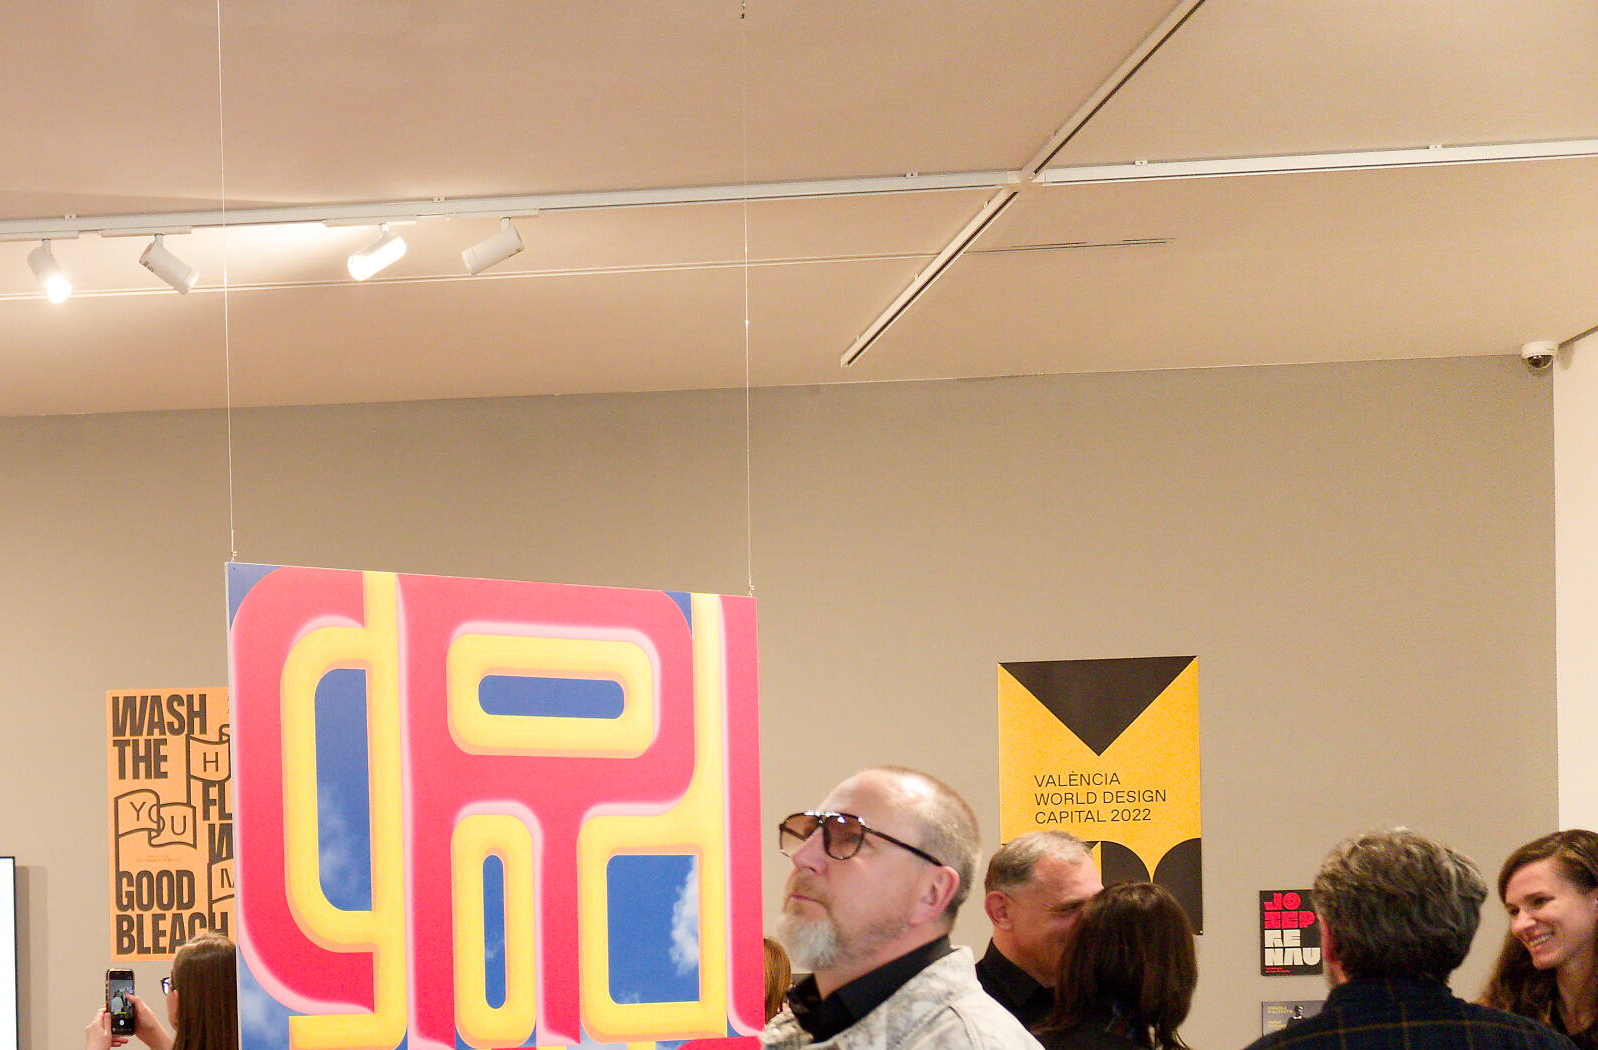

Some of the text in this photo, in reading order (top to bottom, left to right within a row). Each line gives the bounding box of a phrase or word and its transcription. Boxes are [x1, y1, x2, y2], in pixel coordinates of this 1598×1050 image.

[112, 694, 207, 736] WASH
[113, 739, 168, 780] THE
[1034, 771, 1121, 787] VALÈNCIA
[1034, 789, 1167, 806] WORLD DESIGN
[1035, 808, 1152, 824] CAPITAL 2022
[116, 870, 196, 912] GOOD
